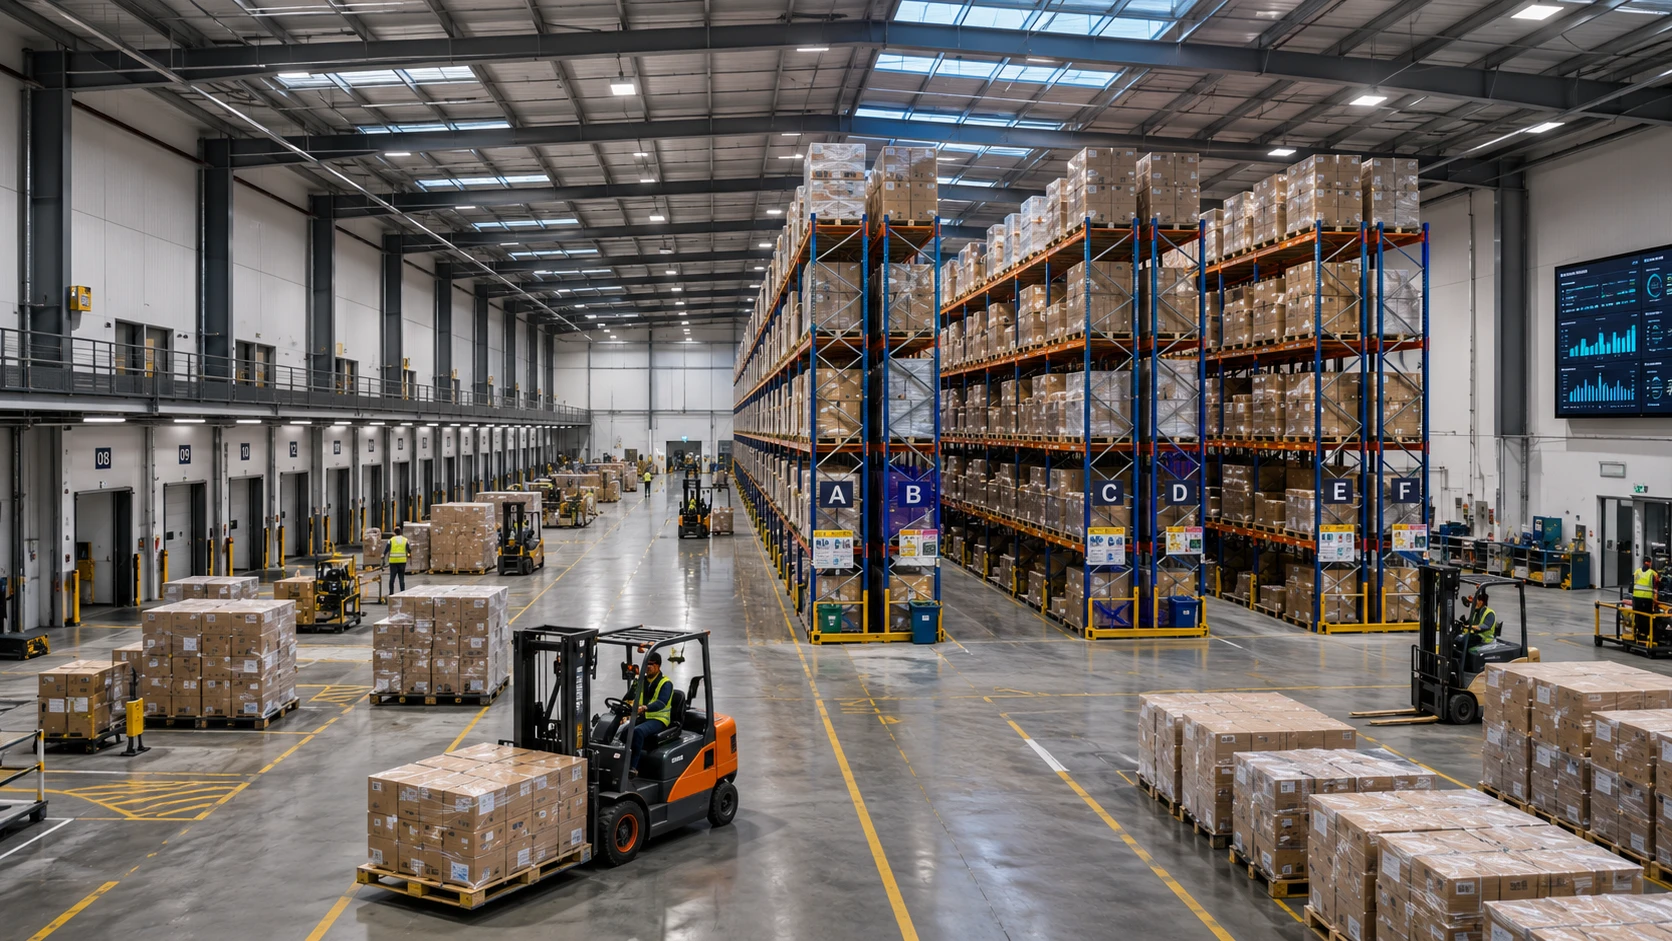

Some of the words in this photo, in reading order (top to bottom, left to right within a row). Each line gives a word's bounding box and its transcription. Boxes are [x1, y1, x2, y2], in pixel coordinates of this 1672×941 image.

[98, 452, 109, 465] 08
[180, 448, 190, 461] 09
[242, 446, 249, 458] 10
[829, 485, 846, 504] A
[906, 485, 921, 504] B
[1102, 484, 1117, 503] C
[1173, 484, 1188, 502] D
[1333, 483, 1347, 501] E
[1399, 482, 1412, 500] F
